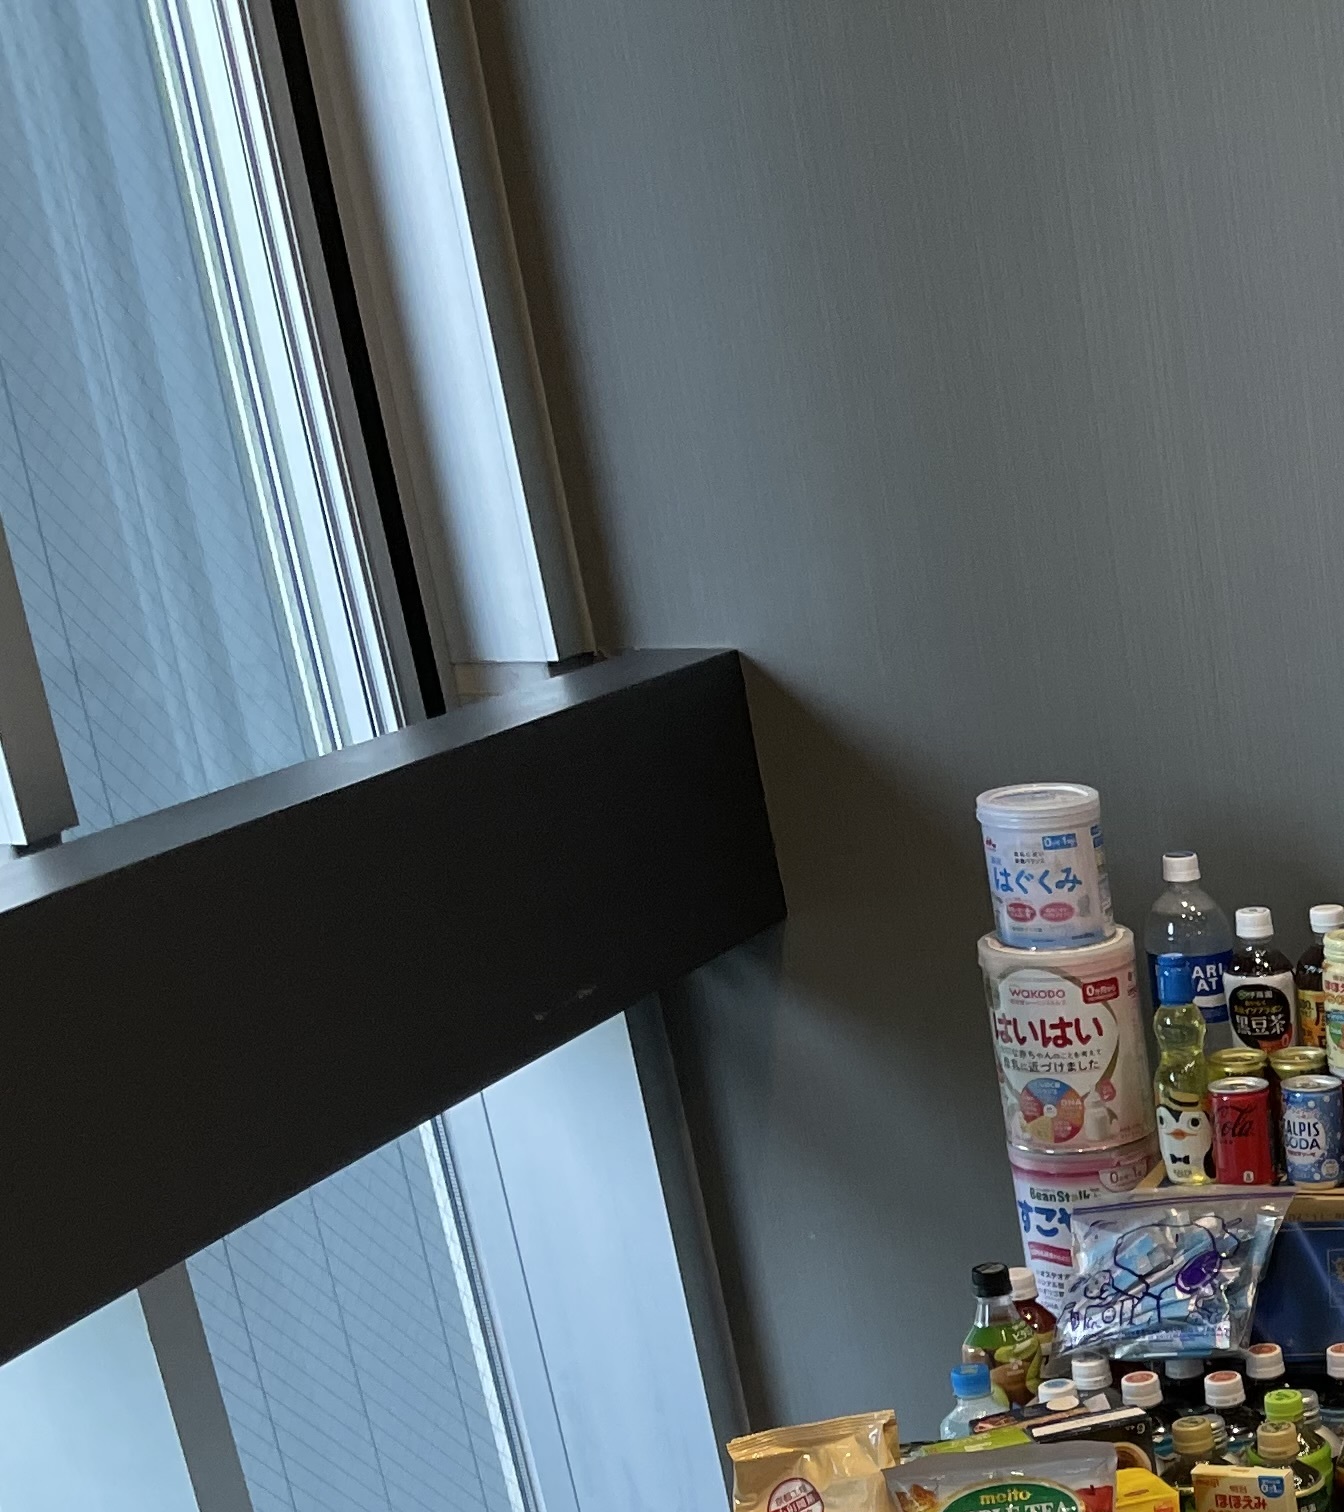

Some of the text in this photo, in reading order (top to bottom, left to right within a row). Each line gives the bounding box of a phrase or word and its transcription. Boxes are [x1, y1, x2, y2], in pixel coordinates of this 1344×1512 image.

[992, 868, 1082, 894] はぐくみ
[995, 1016, 1103, 1043] はいはい
[1236, 1016, 1289, 1037] 黒豆茶
[980, 1488, 1031, 1504] meito
